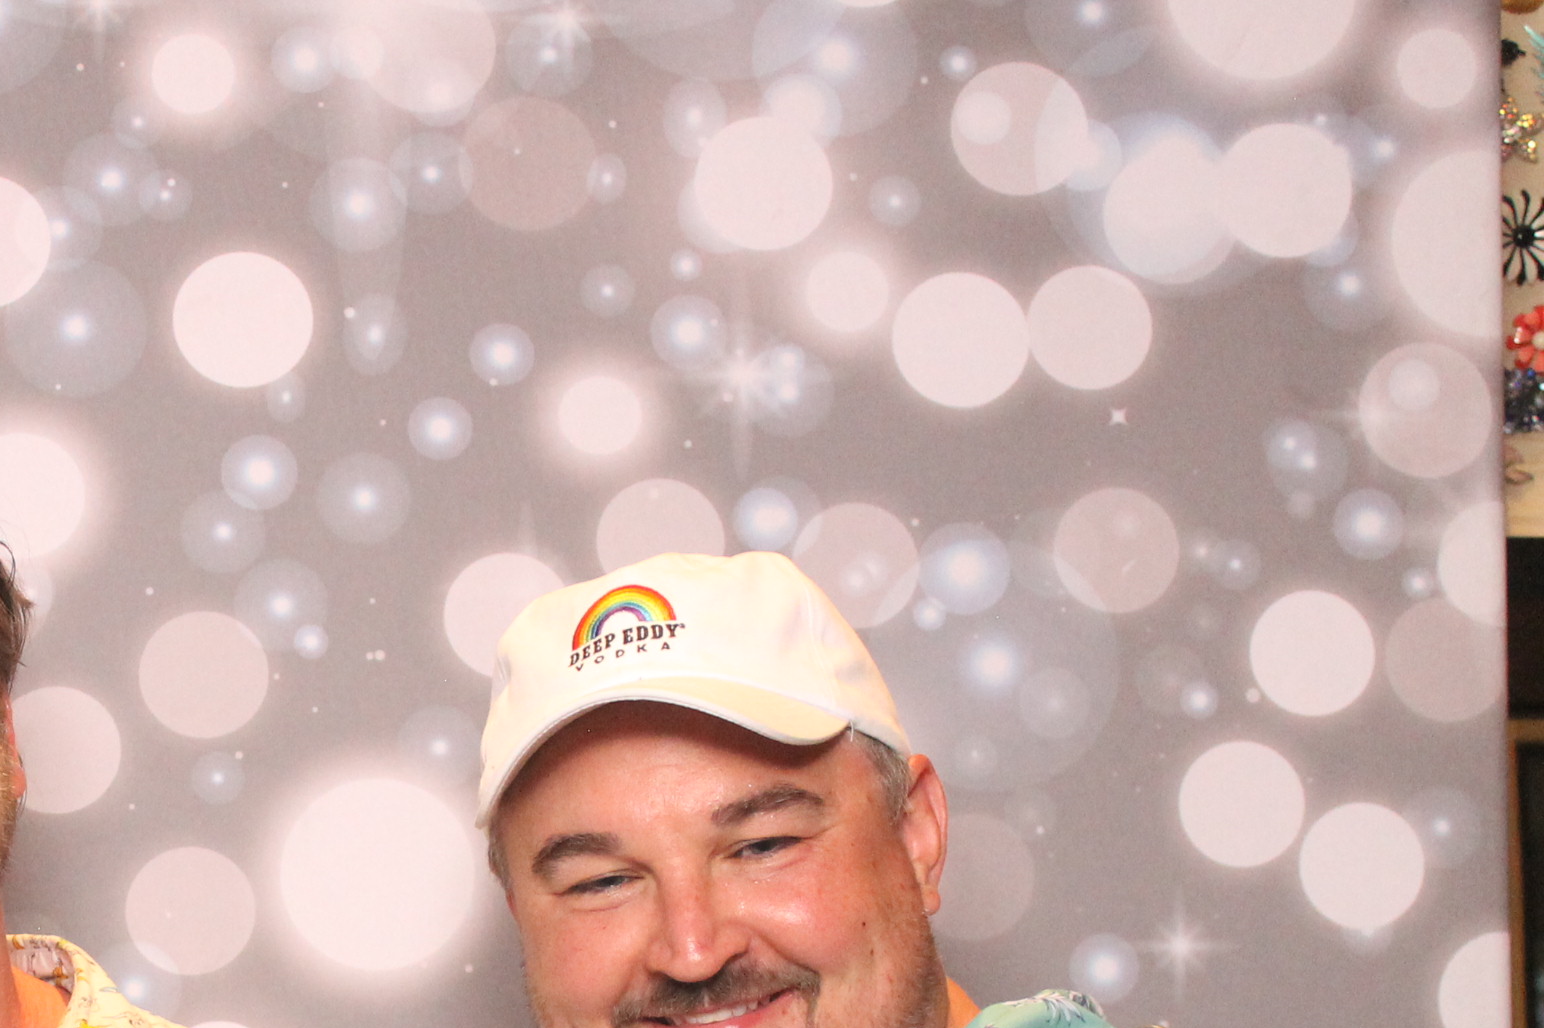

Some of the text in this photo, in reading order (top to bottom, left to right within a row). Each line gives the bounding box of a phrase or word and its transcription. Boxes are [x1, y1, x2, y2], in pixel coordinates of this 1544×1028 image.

[568, 623, 679, 668] DEEP EDDY
[575, 641, 671, 672] VODKA
